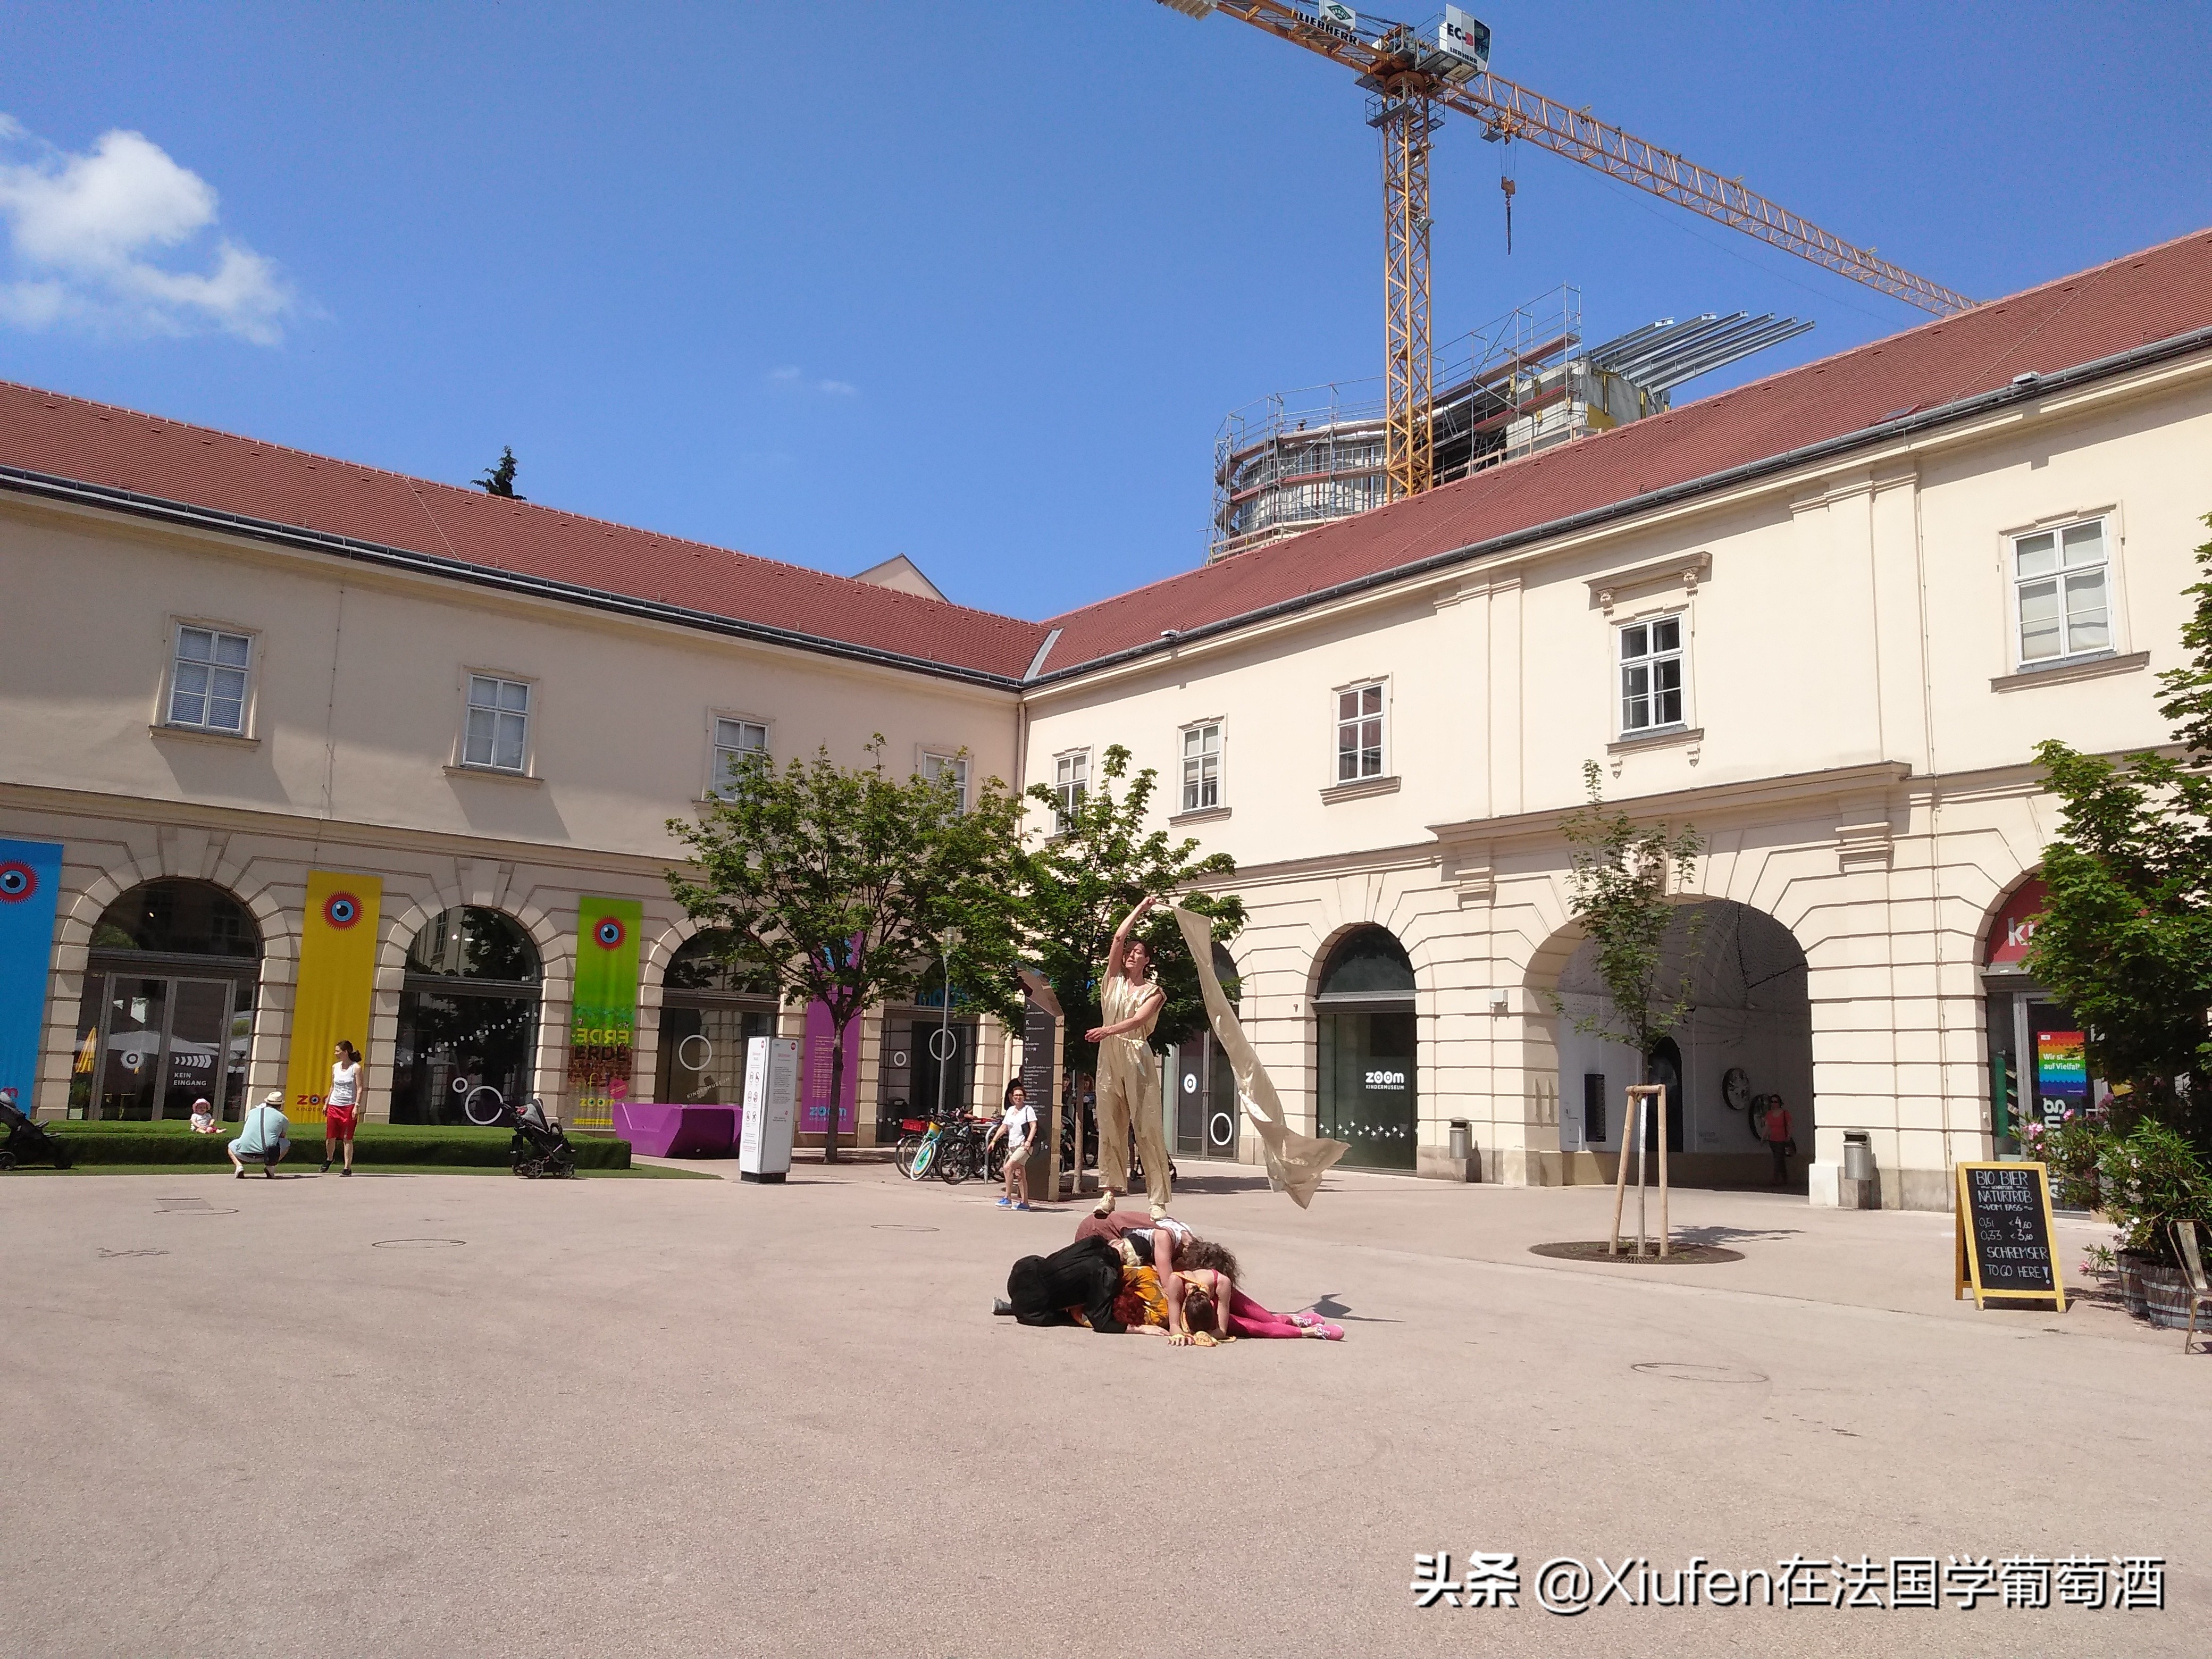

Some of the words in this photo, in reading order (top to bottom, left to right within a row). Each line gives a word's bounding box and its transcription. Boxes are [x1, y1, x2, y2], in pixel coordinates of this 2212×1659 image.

[1298, 11, 1358, 45] LIEBHERR
[1447, 22, 1473, 46] EC-B
[1449, 47, 1478, 64] LIEBHERR
[686, 1077, 731, 1099] KINDERMUSEUM
[1976, 1171, 1995, 1185] BIO
[2000, 1171, 2029, 1186] BIER
[1981, 1230, 2002, 1241] 0,33
[1987, 1246, 2049, 1260] SCHREMSER
